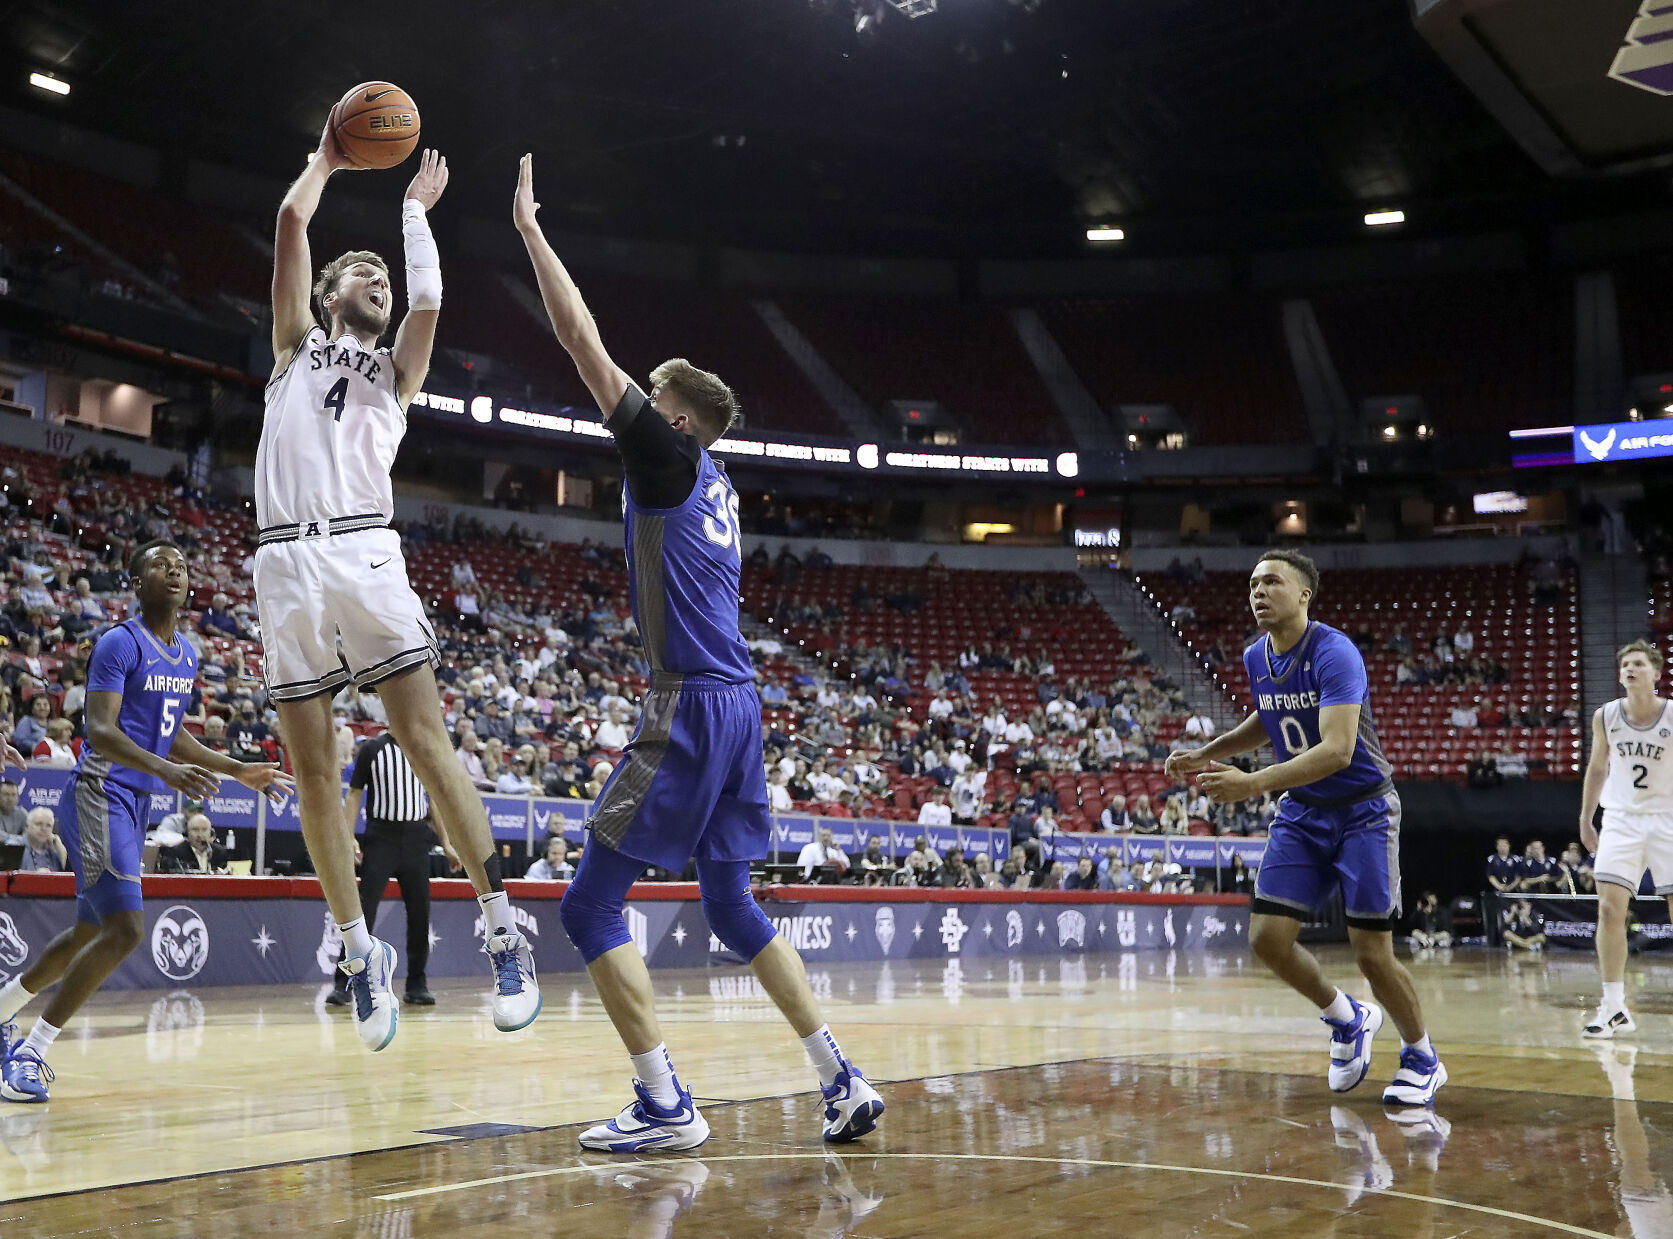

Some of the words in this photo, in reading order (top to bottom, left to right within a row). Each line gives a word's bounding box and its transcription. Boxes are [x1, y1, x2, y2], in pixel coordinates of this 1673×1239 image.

[369, 113, 412, 129] ELITE
[310, 345, 382, 385] STATE
[323, 376, 350, 423] 4
[1619, 436, 1649, 451] AIR
[812, 447, 850, 463] WITH
[885, 452, 961, 469] GREATNESS
[961, 456, 1010, 471] STARTS
[1010, 457, 1049, 472] WITH
[304, 521, 322, 537] A
[1258, 693, 1275, 711] AIR
[1274, 690, 1321, 711] FORCE
[160, 698, 180, 738] 5
[1279, 716, 1310, 756] 0
[1616, 742, 1665, 761] STATE
[1632, 764, 1649, 789] 2
